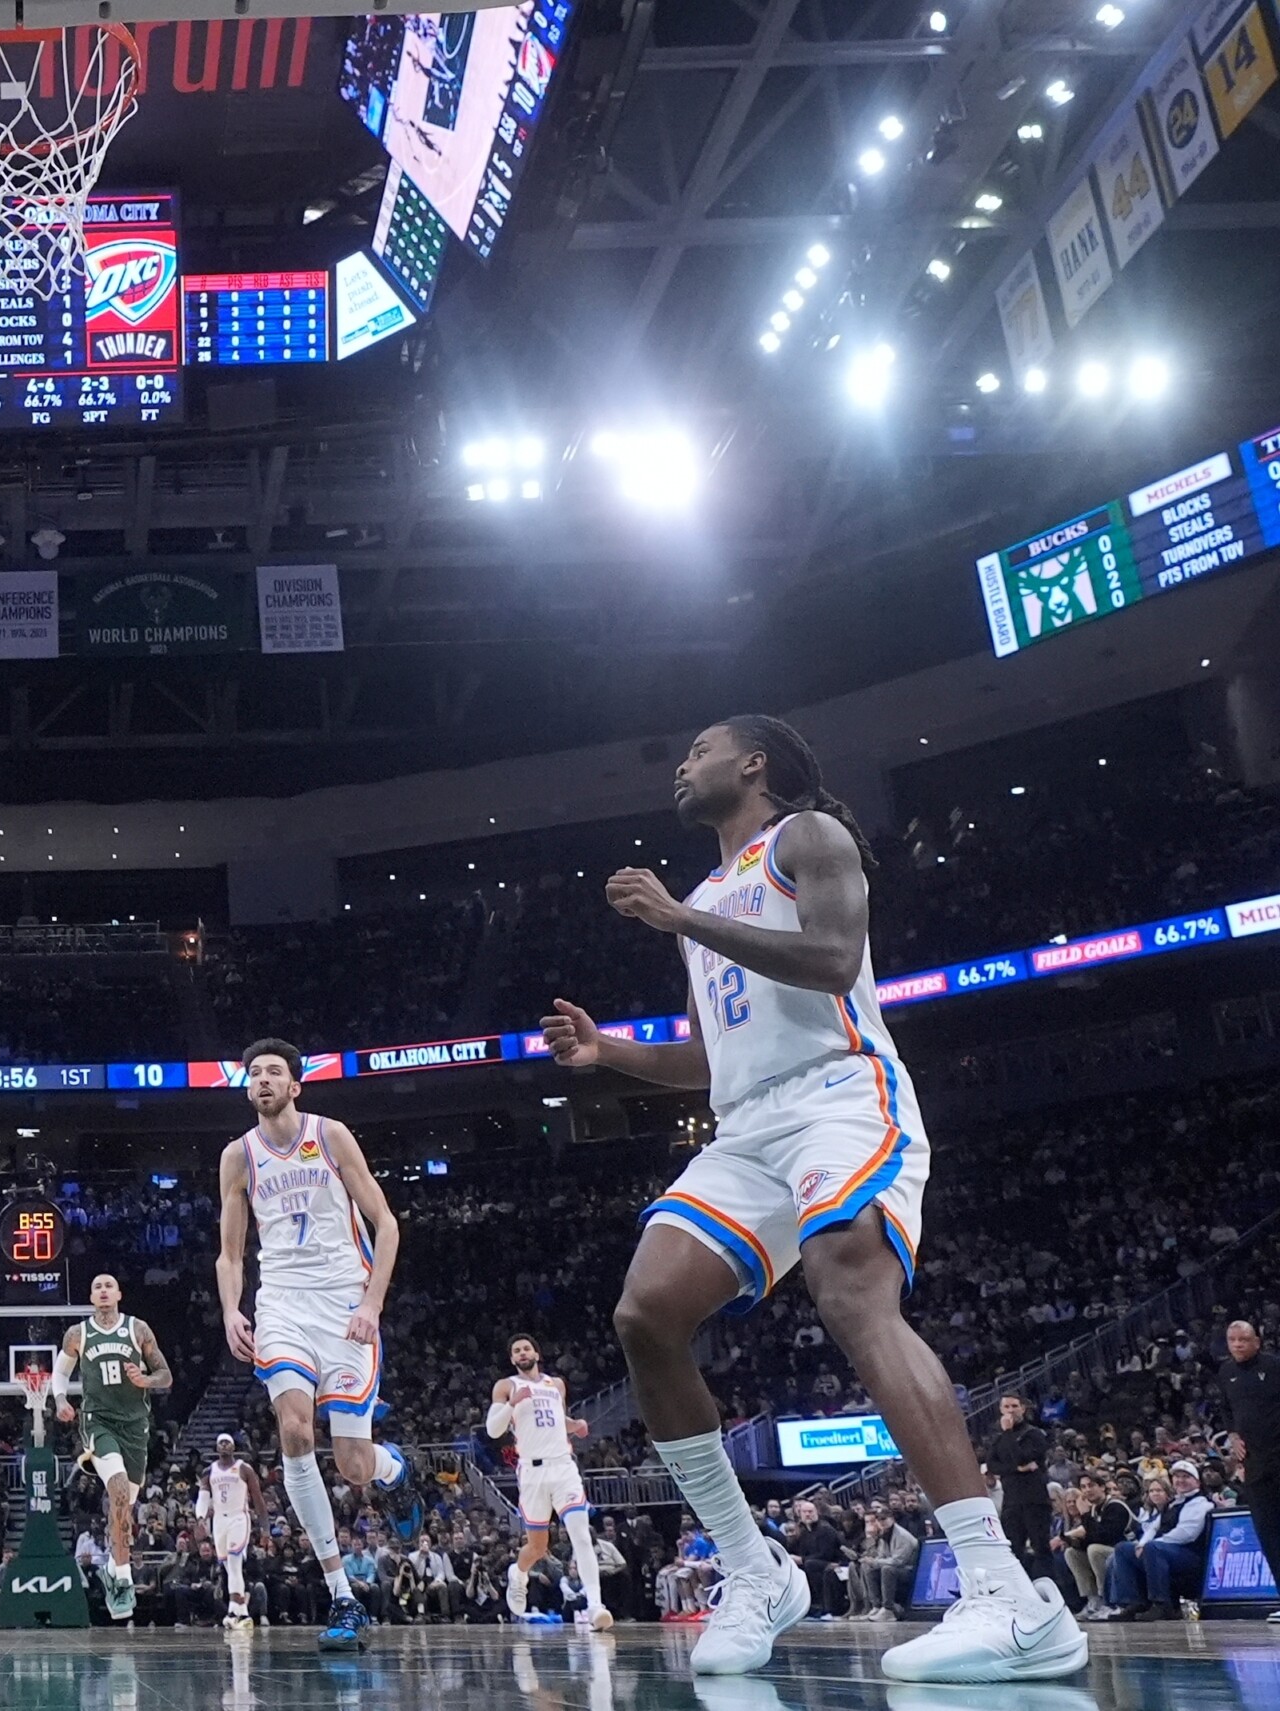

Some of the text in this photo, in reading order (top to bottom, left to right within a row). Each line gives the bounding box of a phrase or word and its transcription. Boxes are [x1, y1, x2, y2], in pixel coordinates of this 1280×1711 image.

[1216, 24, 1257, 93] 14
[493, 152, 513, 179] 5
[121, 203, 160, 221] CITY
[61, 275, 71, 290] 2
[86, 254, 160, 308] OKC
[62, 295, 71, 308] 1
[62, 312, 72, 327] 0
[24, 334, 44, 346] TOV
[62, 331, 73, 346] 4
[95, 332, 166, 360] THUNDER
[63, 351, 72, 364] 1
[27, 378, 55, 393] 4-6
[81, 377, 109, 391] 2-3
[136, 375, 164, 390] 0-0
[24, 394, 62, 407] 66.7%
[78, 393, 116, 406] 66.7%
[140, 391, 171, 404] 0.0%
[32, 412, 51, 424] FG
[83, 411, 108, 422] 3PT
[141, 409, 159, 421] FT
[1147, 467, 1212, 503] MICHELS
[1098, 493, 1212, 553] 0 BLOCKS
[1028, 520, 1089, 558] BUCKS
[1103, 512, 1215, 571] 0 STEALS
[1107, 525, 1233, 589] 2 TURNOVERS
[1111, 540, 1244, 608] 0 PTS FROM TOV
[273, 578, 323, 593] DIVISION
[265, 592, 334, 608] CHAMPIONS
[984, 563, 1012, 647] HUSTLE BOARD
[88, 625, 228, 644] WORLD CHAMPIONS
[1036, 917, 1220, 969] FIELD GOALS 66.7%
[876, 959, 1016, 1003] OINTERS 66.7%
[641, 1024, 654, 1040] 7
[370, 1041, 486, 1071] OKLAHOMA CITY
[60, 1069, 91, 1086] 1ST
[134, 1064, 164, 1087] 10
[257, 1167, 330, 1201] OKLAHOMA
[281, 1190, 310, 1213] CITY
[19, 1213, 54, 1230] 8:55
[291, 1211, 309, 1246] 7
[13, 1230, 52, 1260] 20
[20, 1272, 61, 1282] TISSOT
[85, 1342, 133, 1362] MILWAUKEE
[99, 1360, 122, 1386] 18
[534, 1409, 556, 1428] 25
[802, 1431, 862, 1447] Froedtert
[32, 1471, 47, 1484] GET
[32, 1484, 48, 1497] THE
[1222, 1551, 1261, 1588] RIVALS
[11, 1575, 72, 1594] KIA
